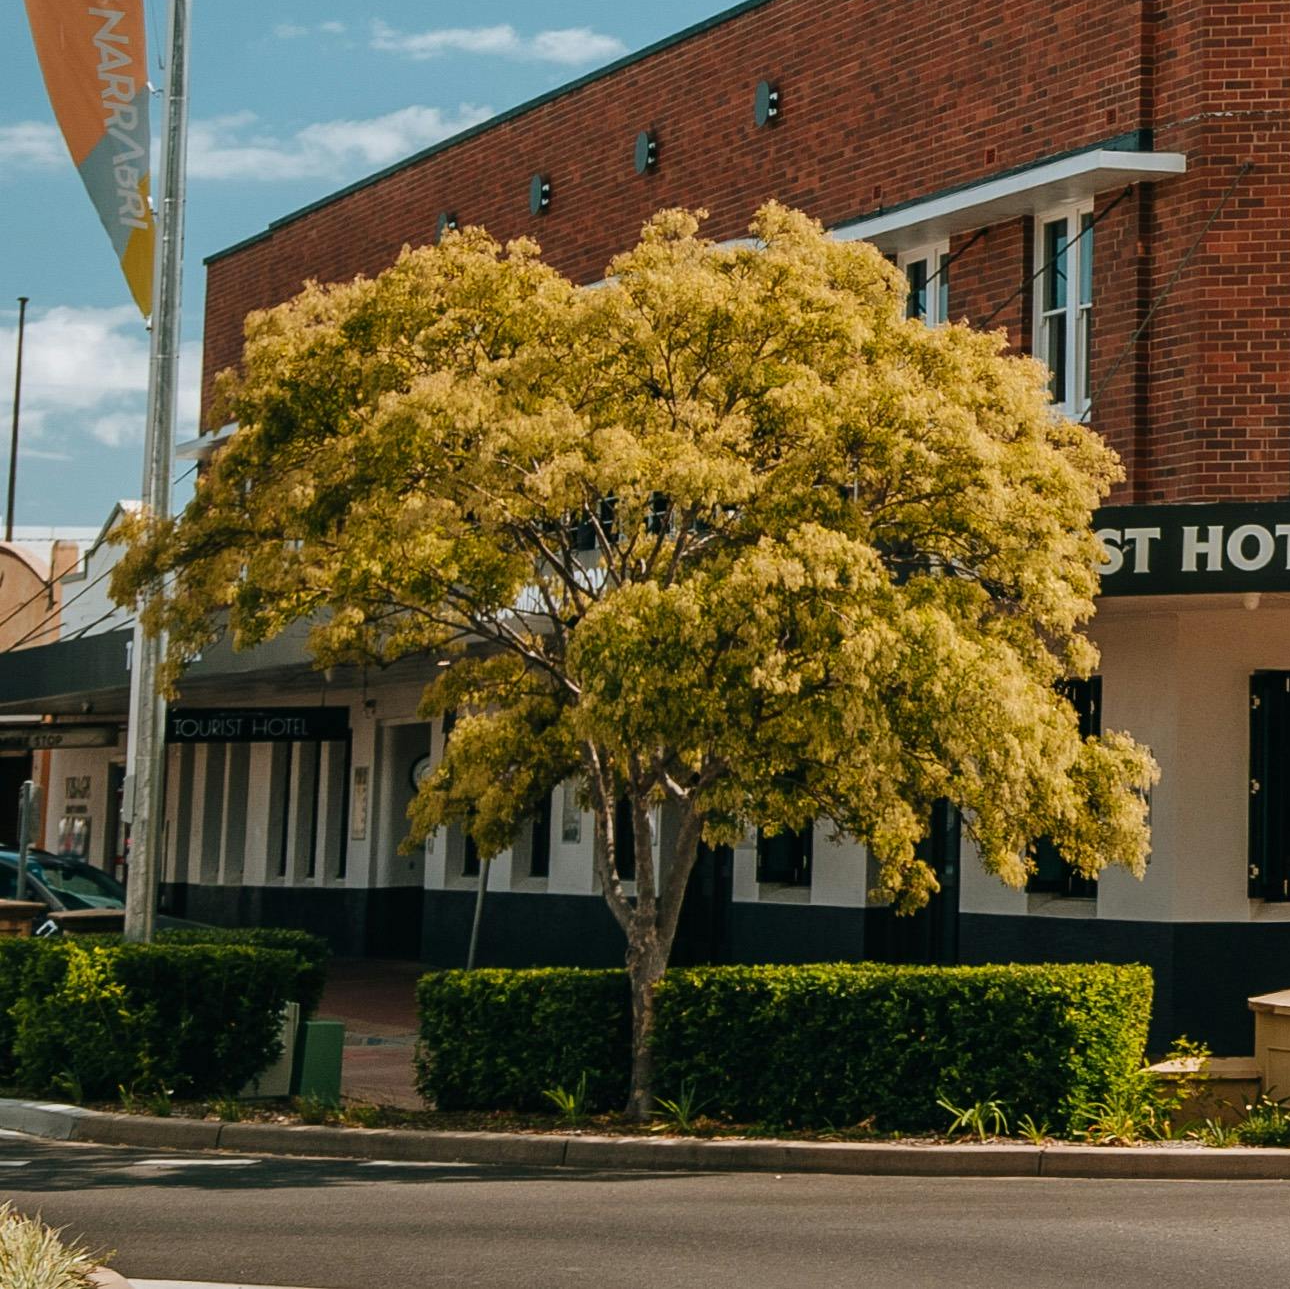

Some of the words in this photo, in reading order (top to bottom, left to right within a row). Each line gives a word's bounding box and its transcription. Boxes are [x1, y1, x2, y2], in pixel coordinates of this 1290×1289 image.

[88, 7, 149, 229] NARRABRI
[1094, 527, 1161, 574] ST
[173, 718, 242, 737] TOURIST
[252, 718, 308, 736] HOTEL
